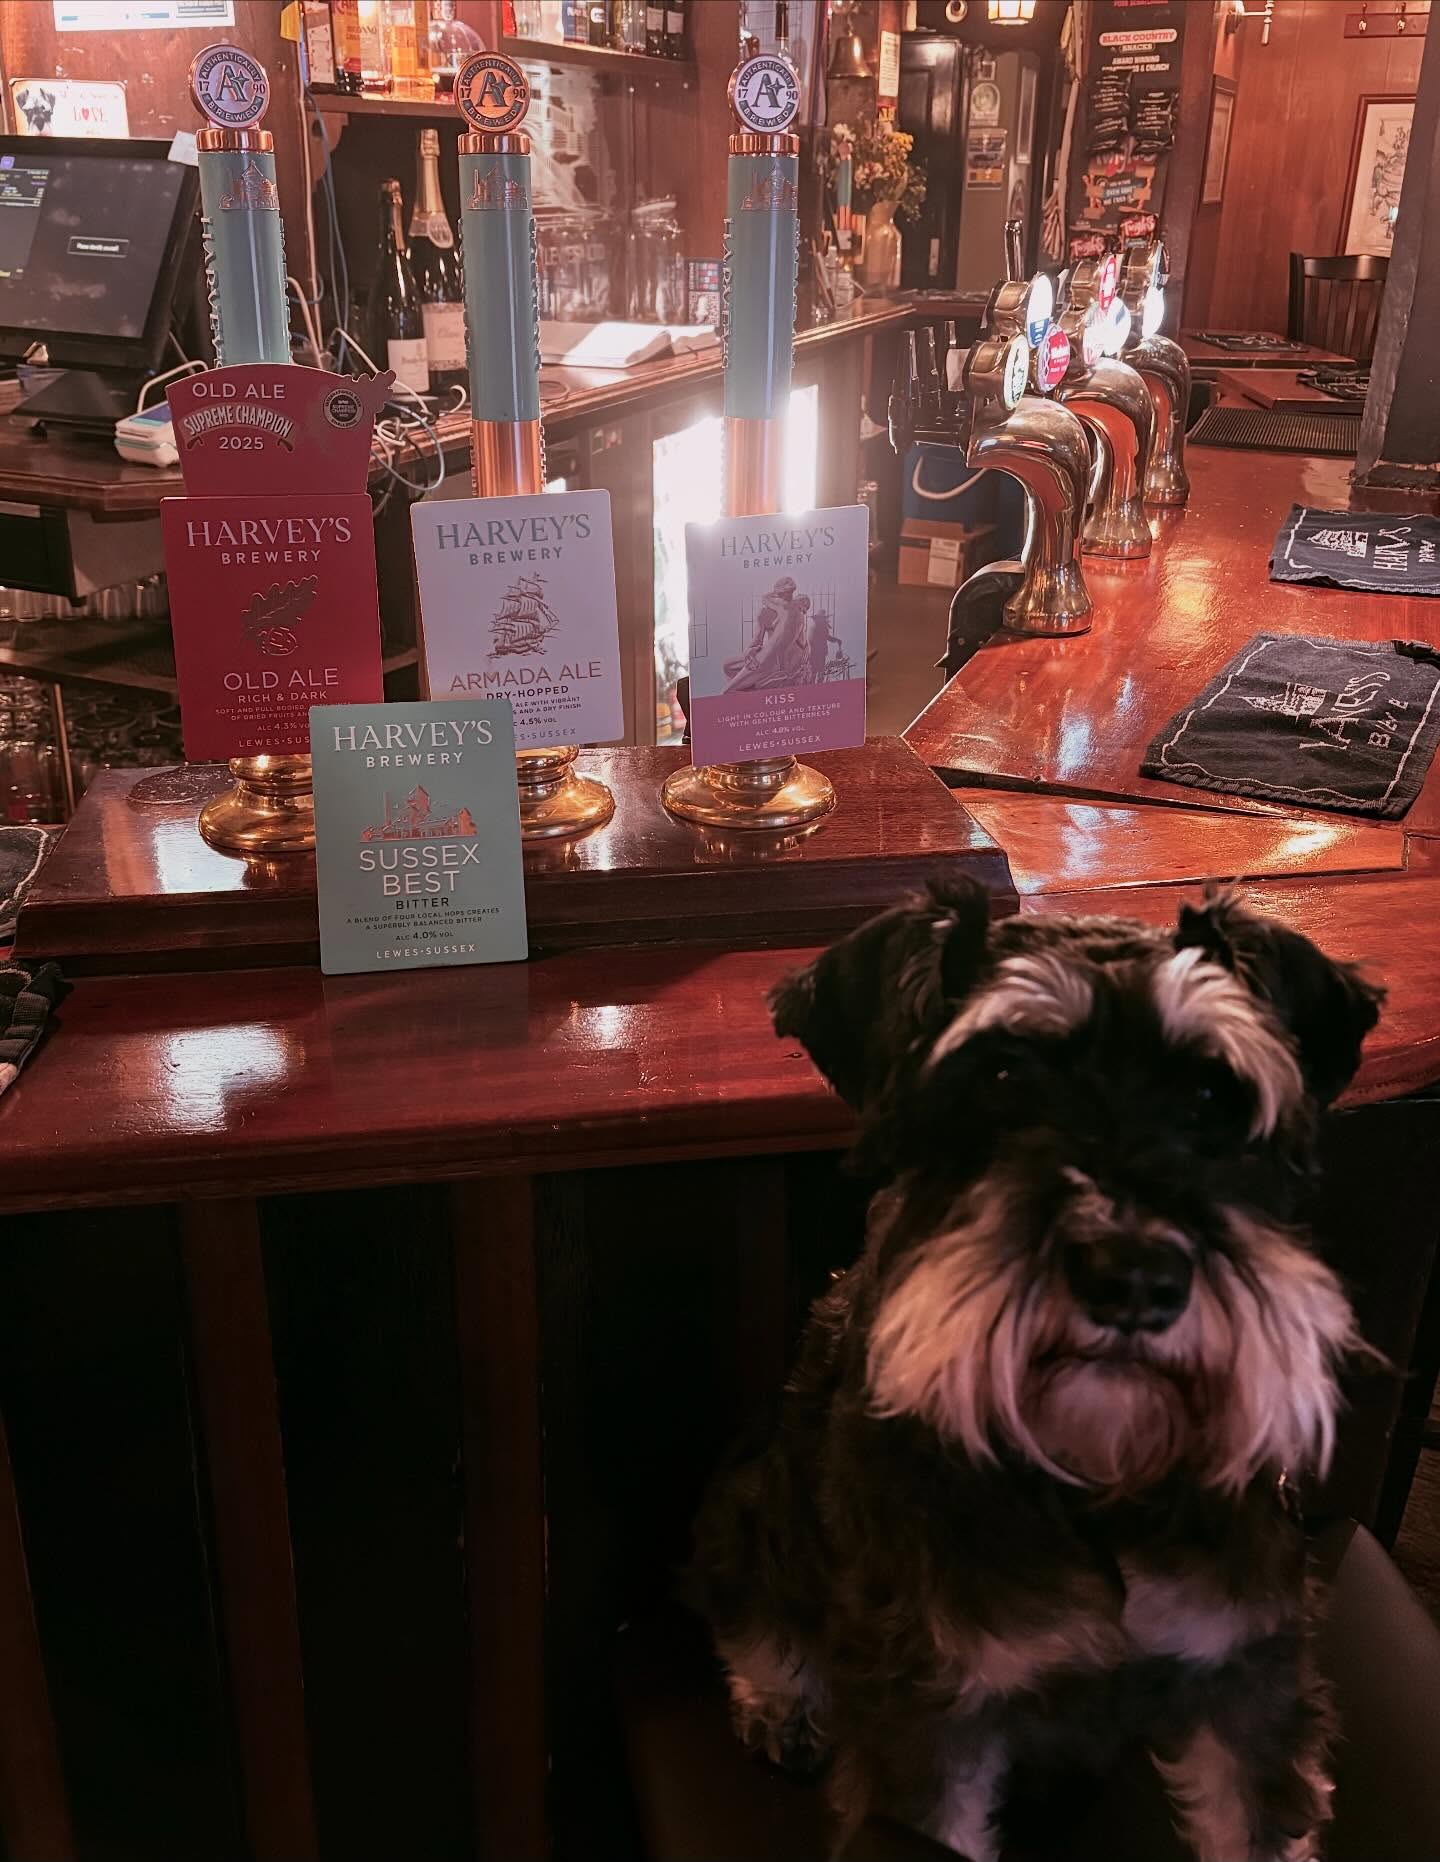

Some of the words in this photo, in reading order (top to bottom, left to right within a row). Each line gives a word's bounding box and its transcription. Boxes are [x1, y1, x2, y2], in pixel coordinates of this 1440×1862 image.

[1102, 34, 1131, 43] BLACK
[1132, 32, 1175, 42] COUNTRY
[201, 52, 262, 80] AUTHENTICALLY
[463, 60, 523, 86] AUTHENTICALLY
[741, 61, 796, 88] AUTHENTICALLY
[199, 81, 210, 92] 17
[253, 84, 266, 94] 90
[460, 87, 471, 99] 17
[513, 88, 526, 99] 90
[738, 89, 748, 99] 17
[786, 90, 798, 100] 90
[208, 102, 259, 120] BREWED
[468, 107, 517, 125] BREWED
[744, 108, 789, 126] BREWED
[192, 382, 236, 399] OLD
[245, 383, 286, 399] ALE
[183, 405, 234, 436] SUPREME
[236, 405, 294, 438] CHAMPION
[219, 437, 264, 450] 2025
[186, 517, 351, 547] HARVEY'S
[436, 513, 591, 550] HARVEY'S
[721, 527, 835, 557] HARVEY'S
[222, 550, 321, 565] BREWERY
[469, 547, 563, 566] BREWERY
[743, 552, 813, 568] BREWERY
[223, 671, 279, 691] OLD
[288, 668, 339, 687] ALE
[450, 667, 552, 692] ARMADA
[559, 661, 602, 681] ALE
[238, 694, 270, 703] RICH
[277, 693, 284, 701] &
[290, 691, 327, 700] DARK
[486, 685, 569, 700] DRY-HOPPED
[550, 696, 580, 704] VIBRANT
[765, 693, 795, 705] KISS
[718, 715, 740, 723] LIGHT
[754, 709, 786, 718] COLOUR
[808, 702, 841, 711] TEXTURE
[729, 720, 749, 728] WITH
[752, 717, 781, 725] GENTLE
[784, 710, 830, 720] BITTERNESS
[274, 722, 298, 730] 4.3%
[520, 717, 541, 726] 4.5%
[333, 720, 493, 751] HARVEY'S
[366, 752, 464, 768] BREWERY
[359, 843, 481, 872] SUSSEX
[383, 870, 460, 896] BEST
[396, 897, 450, 910] BITTER
[354, 916, 379, 924] BLEND
[382, 914, 392, 922] OF
[394, 913, 415, 921] FOUR
[467, 907, 500, 916] CREATES
[373, 921, 411, 930] SUPERBLY
[413, 918, 454, 927] BALANCED
[456, 916, 482, 924] BITTER
[412, 931, 437, 940] 4.0%
